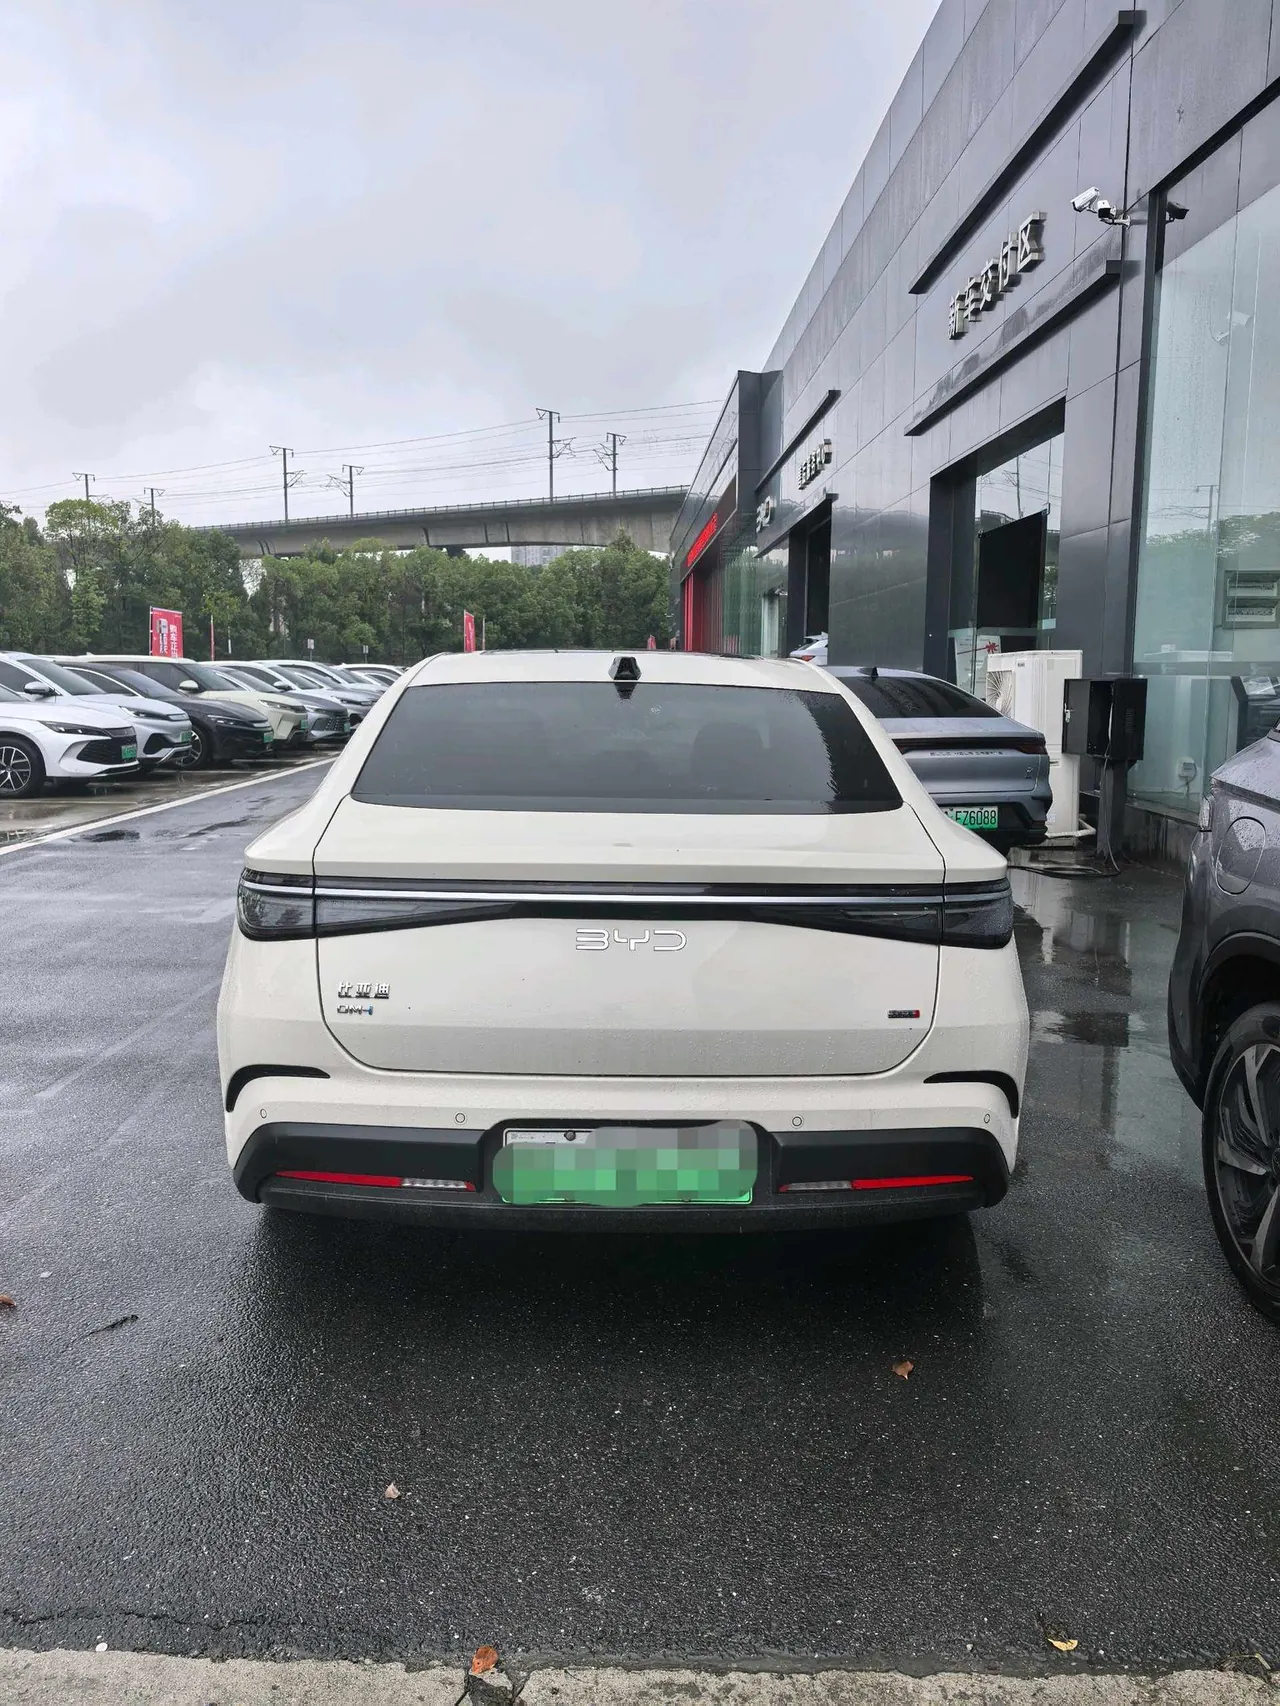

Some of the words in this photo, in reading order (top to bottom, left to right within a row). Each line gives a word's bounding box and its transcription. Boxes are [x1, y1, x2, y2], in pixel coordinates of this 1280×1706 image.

[949, 212, 1044, 339] 新车交付区
[575, 928, 688, 952] BYD
[337, 981, 391, 1000] 比亚迪
